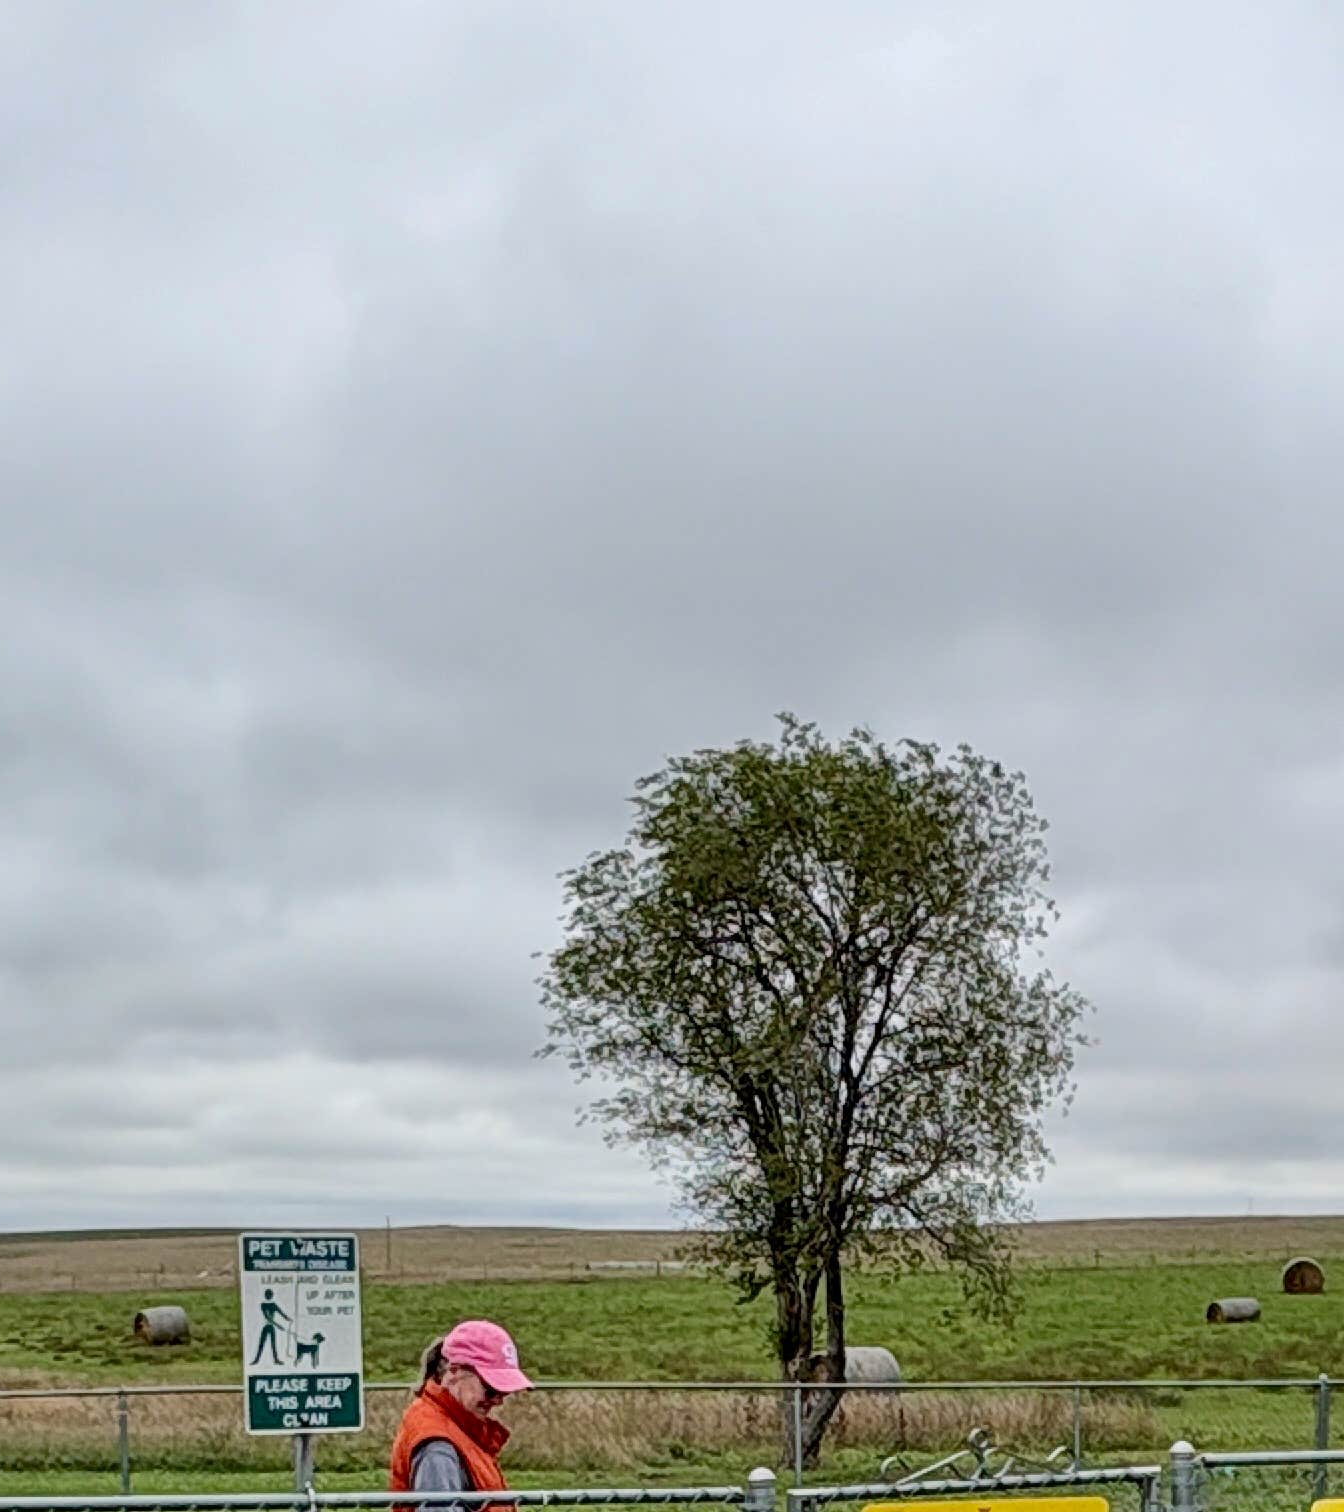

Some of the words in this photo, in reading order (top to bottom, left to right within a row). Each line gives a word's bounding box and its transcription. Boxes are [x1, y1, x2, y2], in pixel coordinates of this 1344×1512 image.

[248, 1240, 283, 1257] PET
[290, 1240, 350, 1257] WASTE
[254, 1377, 309, 1394] PLEASE
[316, 1376, 352, 1393] KEEP
[267, 1396, 298, 1411] THIS
[304, 1395, 342, 1410] AREA
